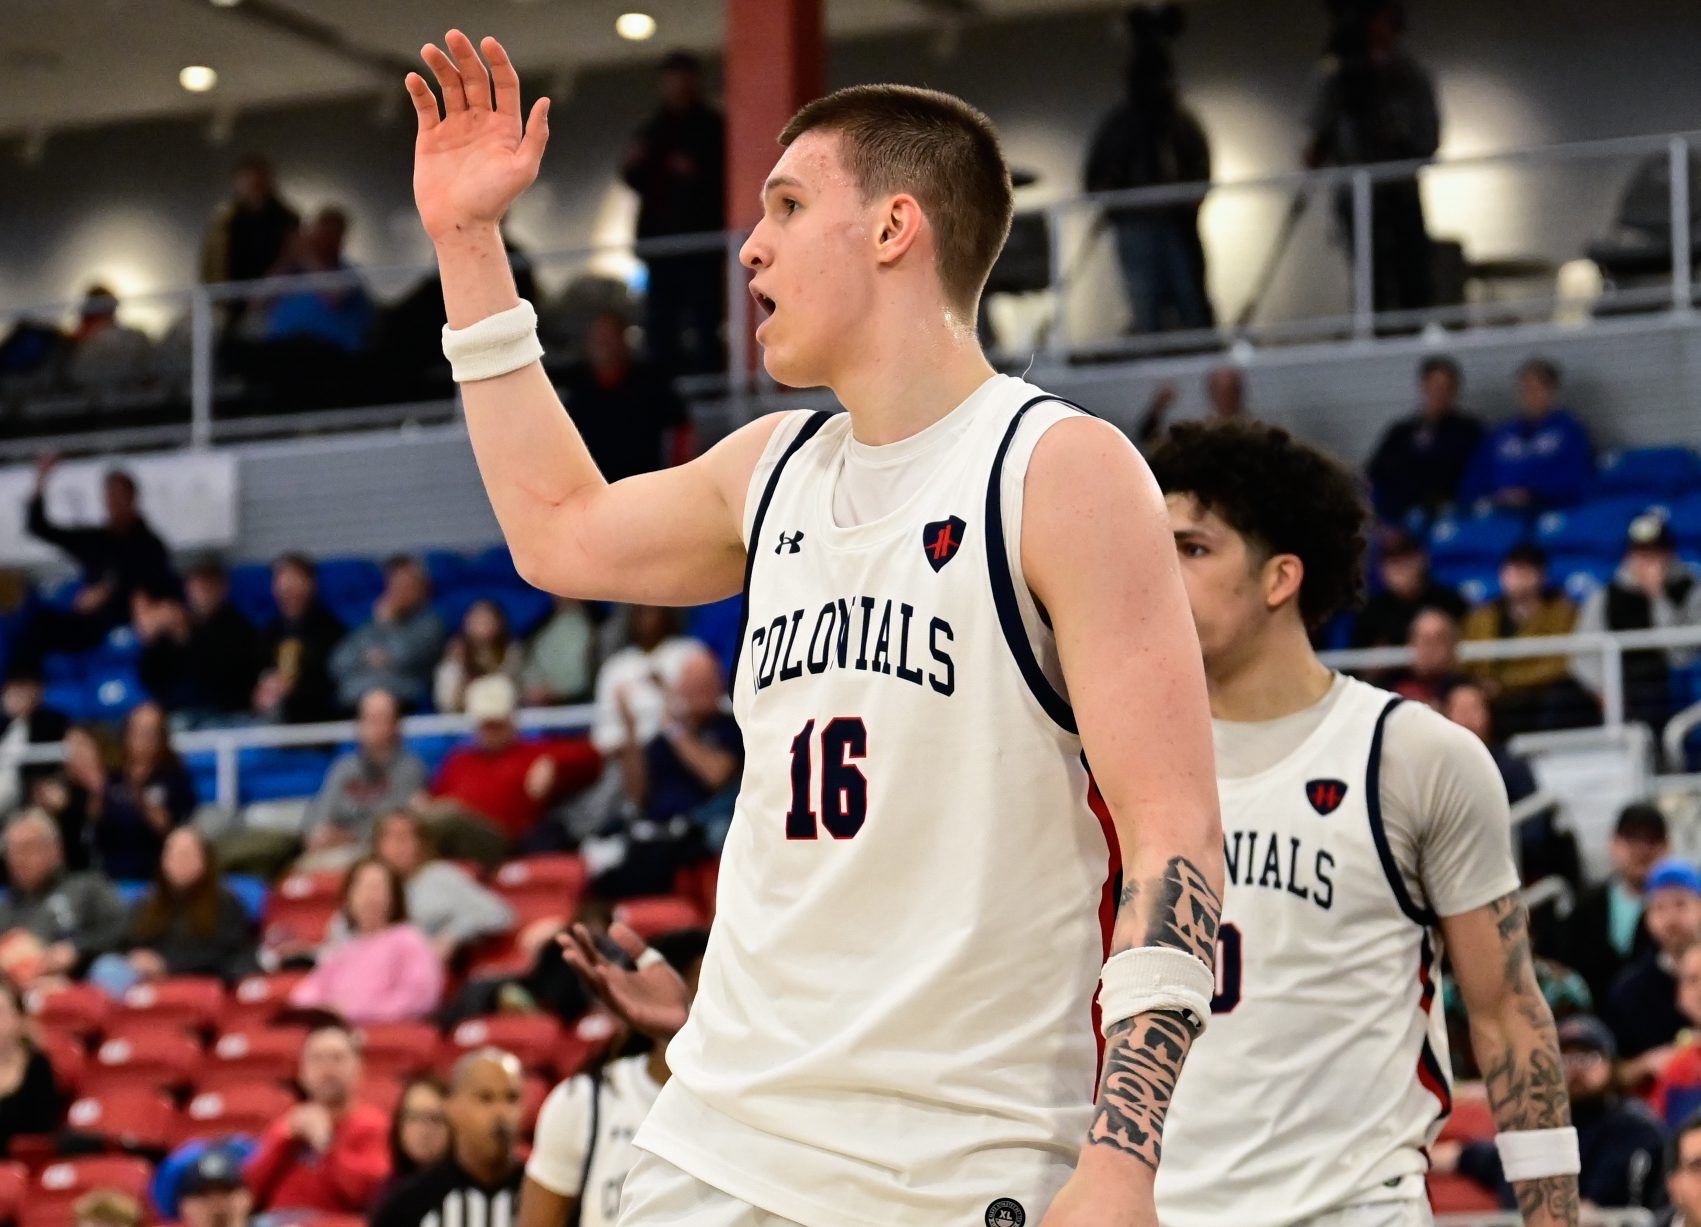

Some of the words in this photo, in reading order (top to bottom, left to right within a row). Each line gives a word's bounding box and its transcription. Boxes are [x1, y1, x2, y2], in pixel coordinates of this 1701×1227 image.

[751, 595, 955, 697] COLONIALS
[785, 716, 867, 841] 16
[999, 1209, 1013, 1220] XL
